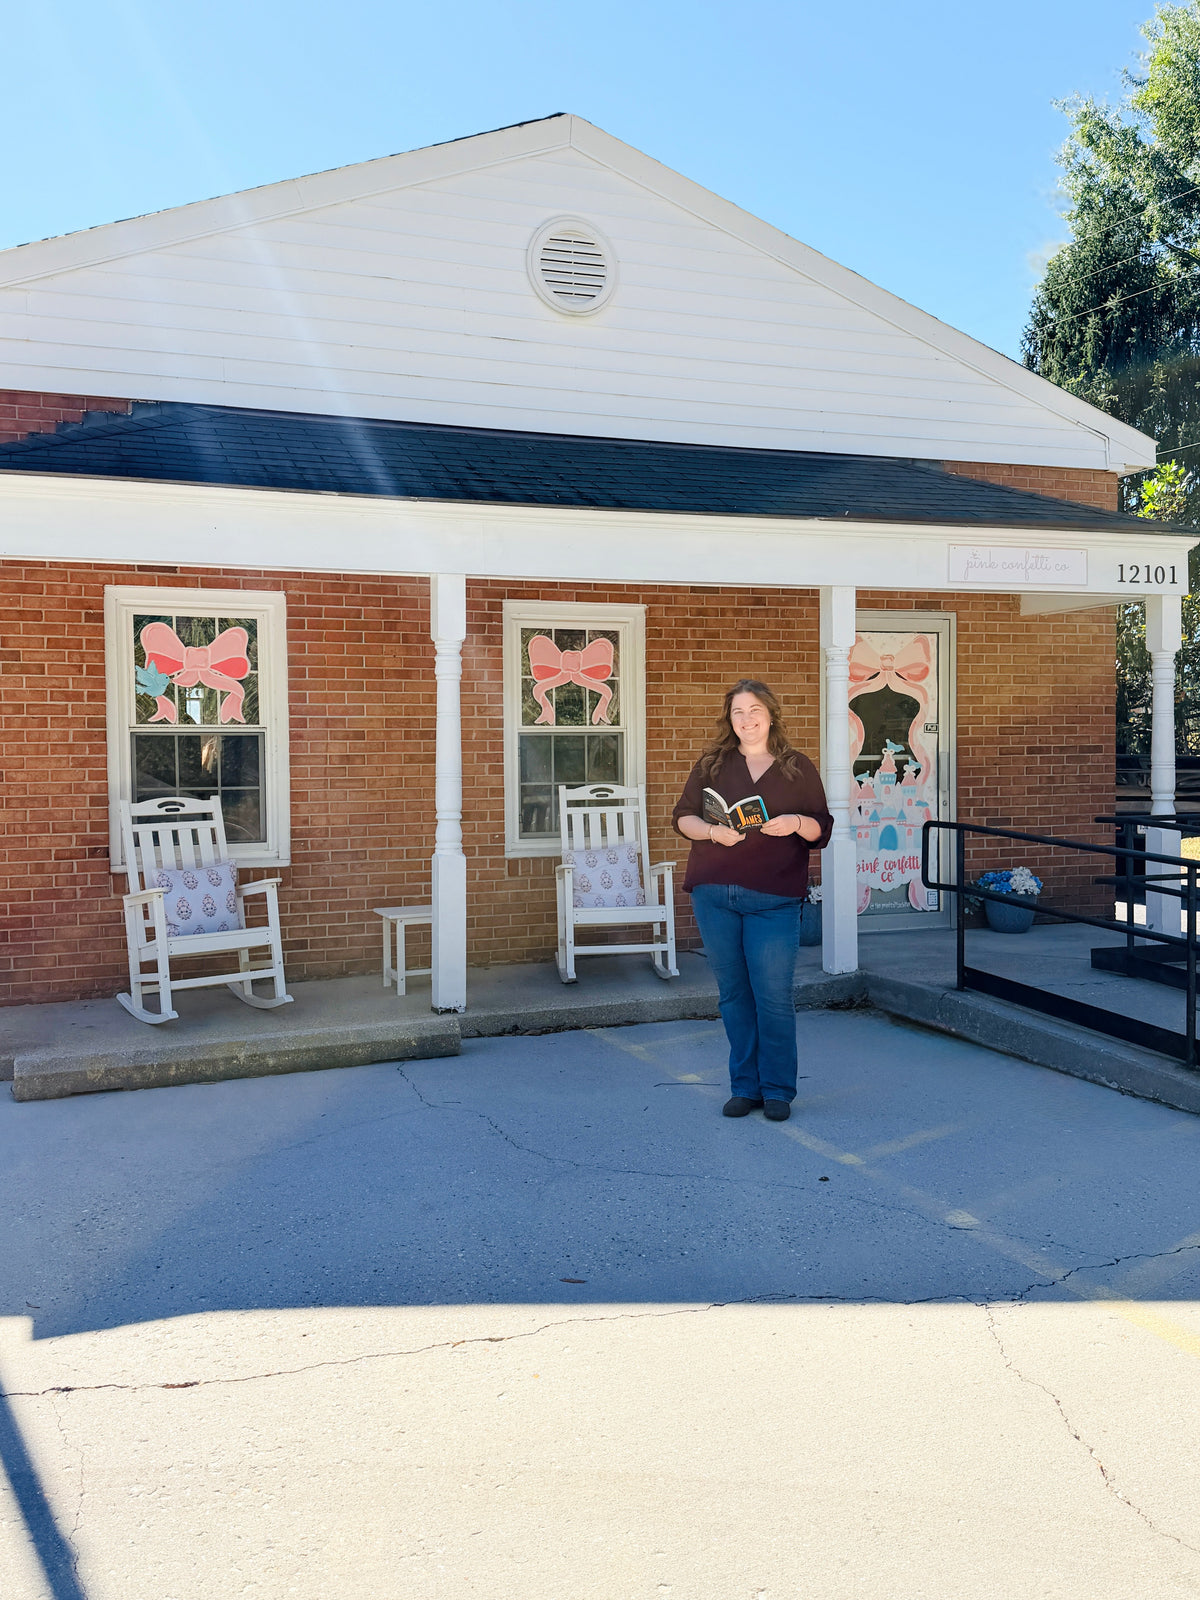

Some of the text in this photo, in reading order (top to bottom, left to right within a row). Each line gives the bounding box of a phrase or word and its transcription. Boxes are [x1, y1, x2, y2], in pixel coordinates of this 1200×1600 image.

[964, 550, 1070, 581] pink confetti co
[1117, 563, 1178, 584] 12101
[884, 855, 921, 875] confetti
